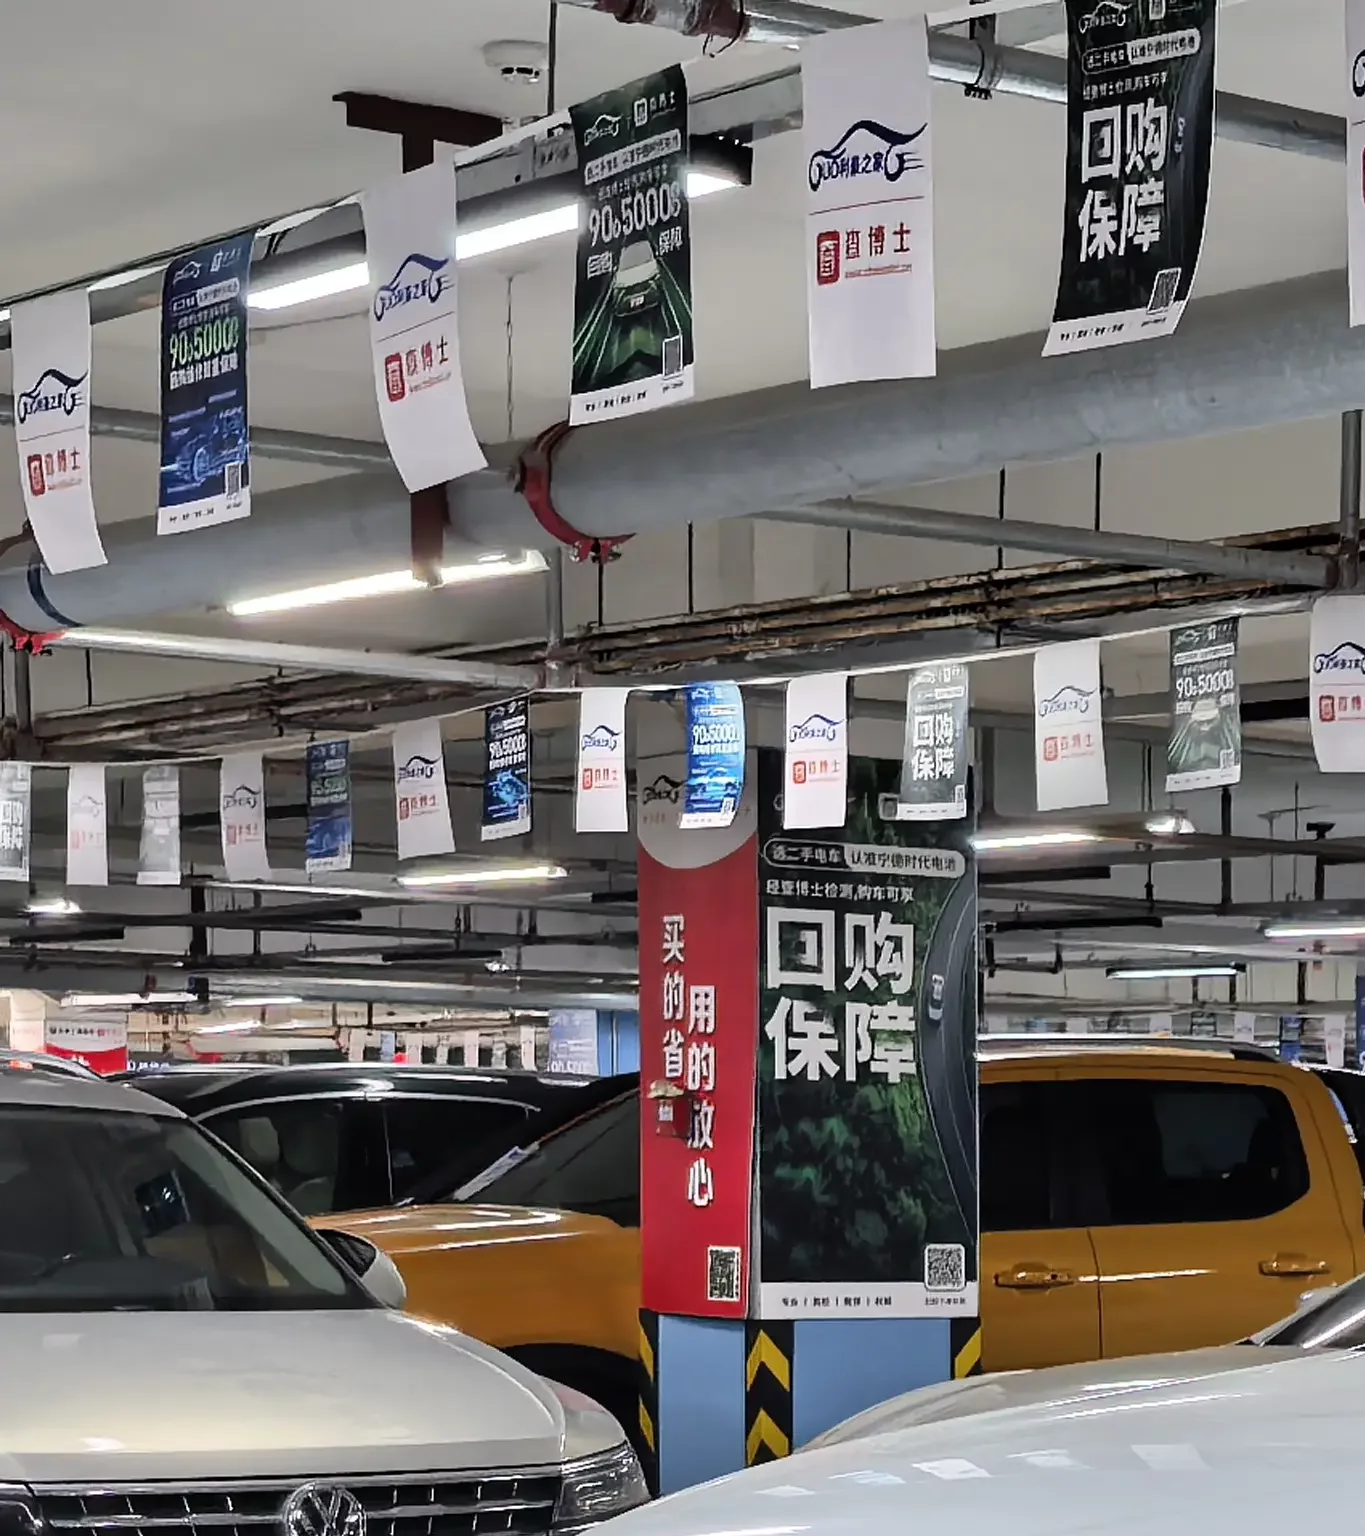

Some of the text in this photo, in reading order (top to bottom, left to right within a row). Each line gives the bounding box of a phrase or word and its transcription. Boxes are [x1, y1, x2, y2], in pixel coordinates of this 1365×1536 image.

[1082, 97, 1168, 184] 回购
[1077, 178, 1167, 263] 保障
[911, 748, 955, 781] 保障
[912, 712, 954, 748] 回购
[765, 906, 915, 994] 回购
[765, 995, 919, 1084] 保障
